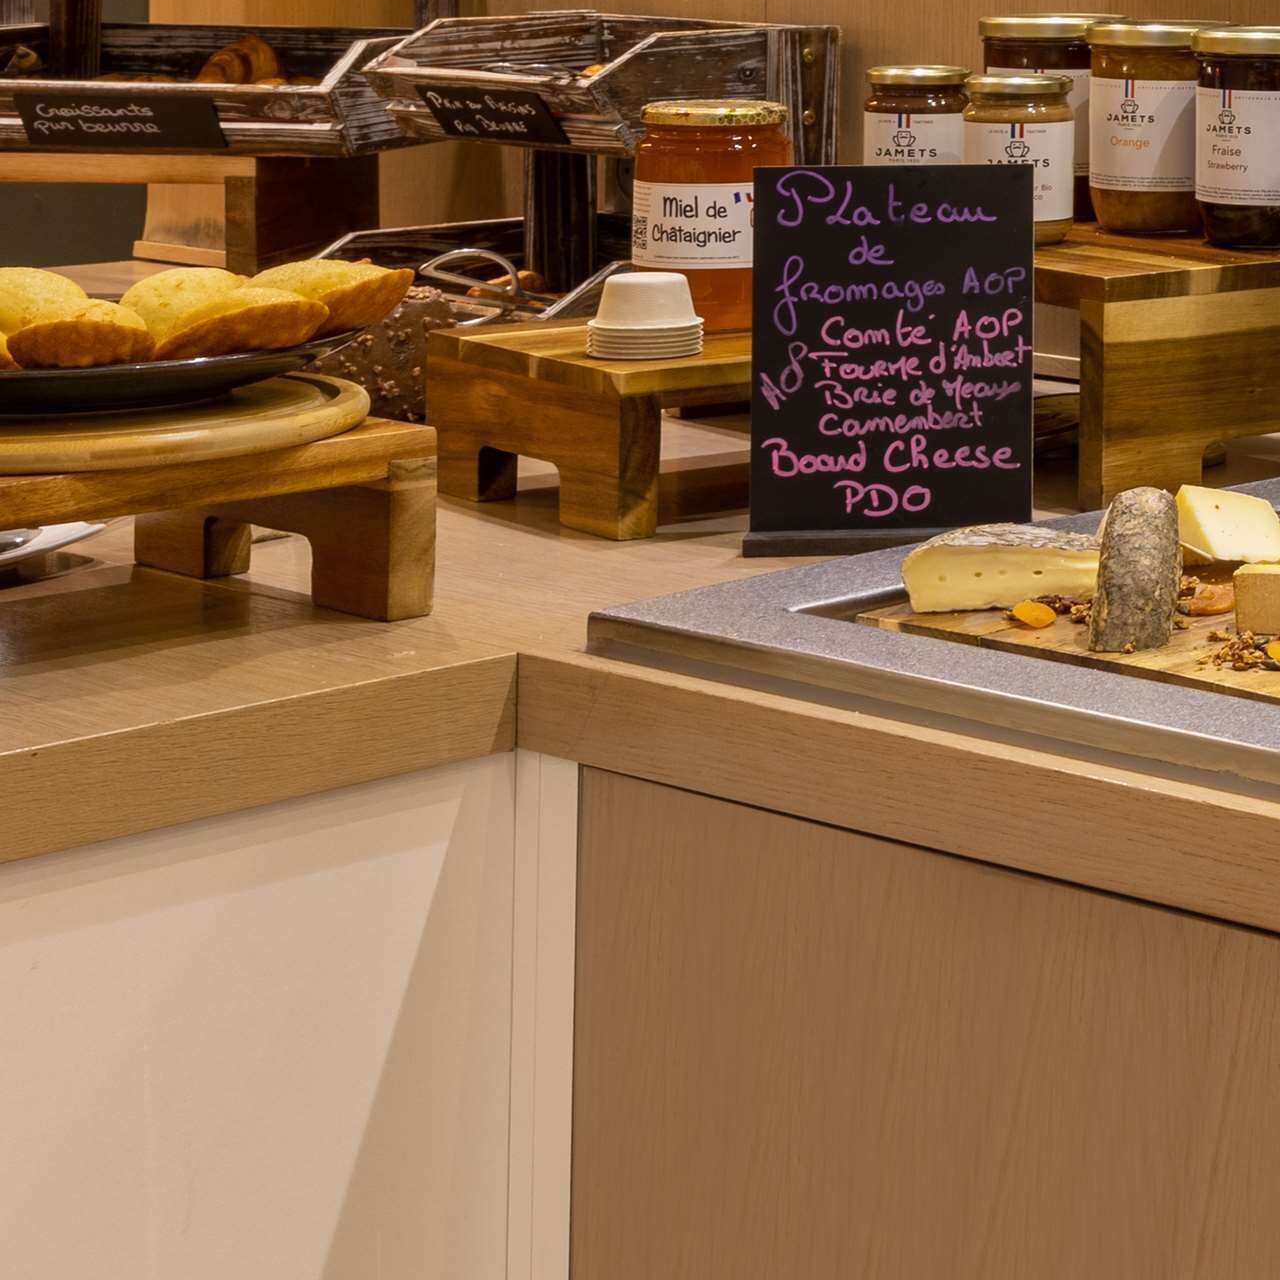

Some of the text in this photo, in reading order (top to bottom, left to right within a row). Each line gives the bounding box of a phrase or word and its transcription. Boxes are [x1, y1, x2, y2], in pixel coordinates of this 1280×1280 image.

[35, 103, 154, 118] Croissants
[1106, 113, 1155, 123] JAMETS
[1206, 124, 1252, 135] JAMETS
[875, 148, 937, 157] JAMETS
[1110, 136, 1151, 150] Orange
[1212, 144, 1242, 157] Fraise
[1207, 160, 1249, 173] Strawberry
[663, 195, 699, 218] Miel
[706, 201, 728, 219] de
[652, 224, 742, 248] Châtaignier
[849, 236, 894, 265] de
[962, 267, 1026, 294] AOP
[820, 308, 1023, 348] Comté AOP
[910, 380, 936, 406] de
[883, 435, 1021, 473] Cheese
[833, 480, 932, 517] PDO
